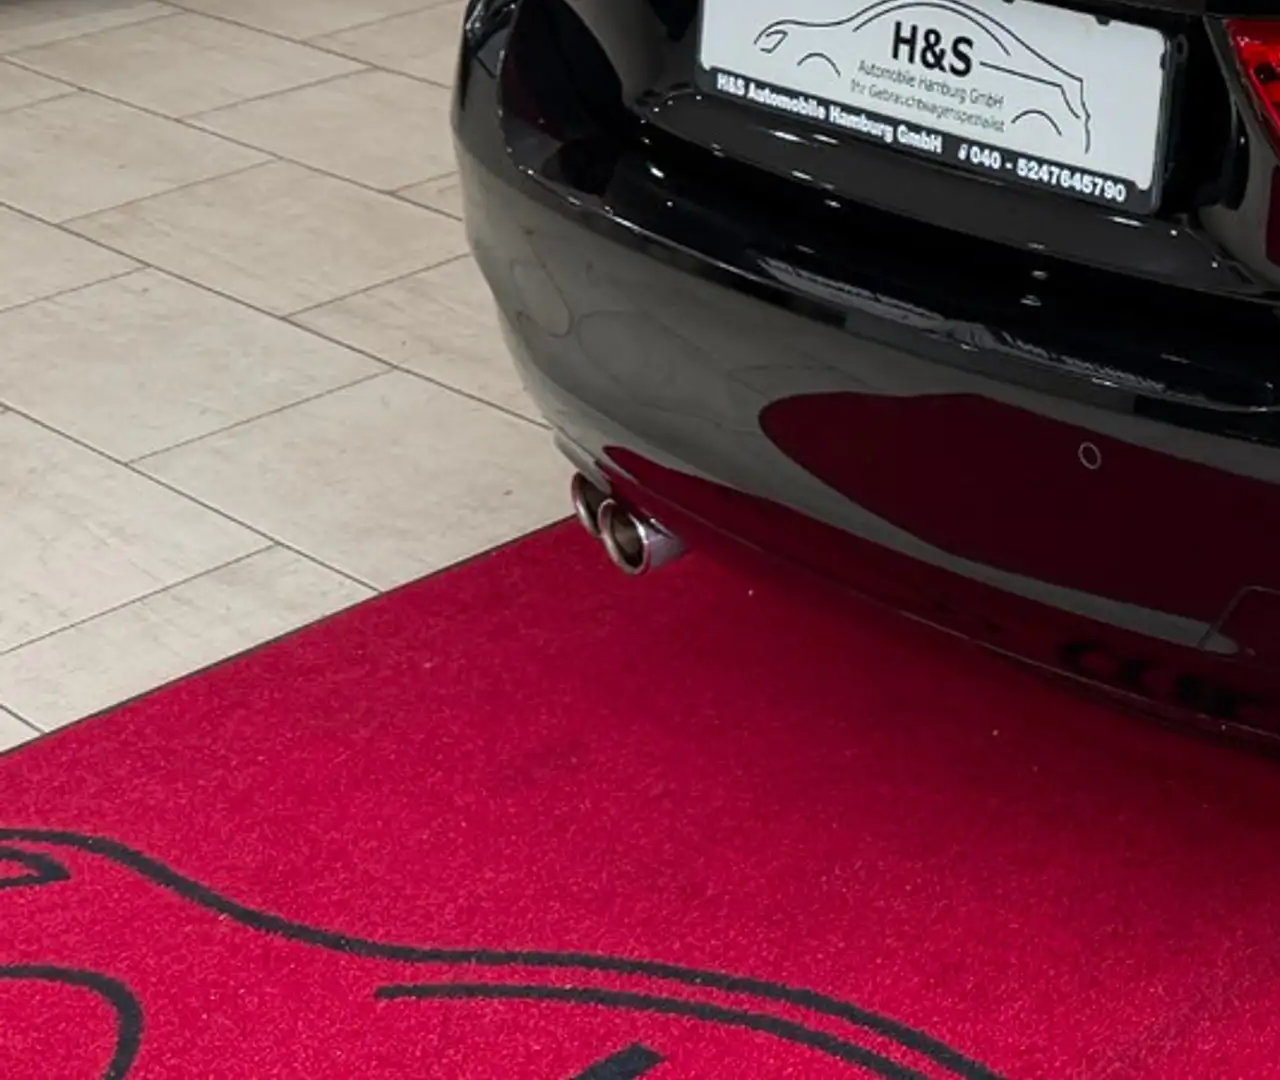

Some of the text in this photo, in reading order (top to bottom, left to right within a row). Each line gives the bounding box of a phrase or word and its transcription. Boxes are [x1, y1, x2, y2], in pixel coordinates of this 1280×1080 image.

[892, 21, 974, 77] H&S
[857, 60, 1005, 107] Automobile Hamburg GmbH
[716, 72, 746, 97] H&S
[747, 81, 826, 120] Automobile
[828, 104, 894, 144] Hamburg
[896, 124, 943, 155] GmbH
[969, 146, 1001, 170] 040
[1015, 158, 1127, 203] 5247645790
